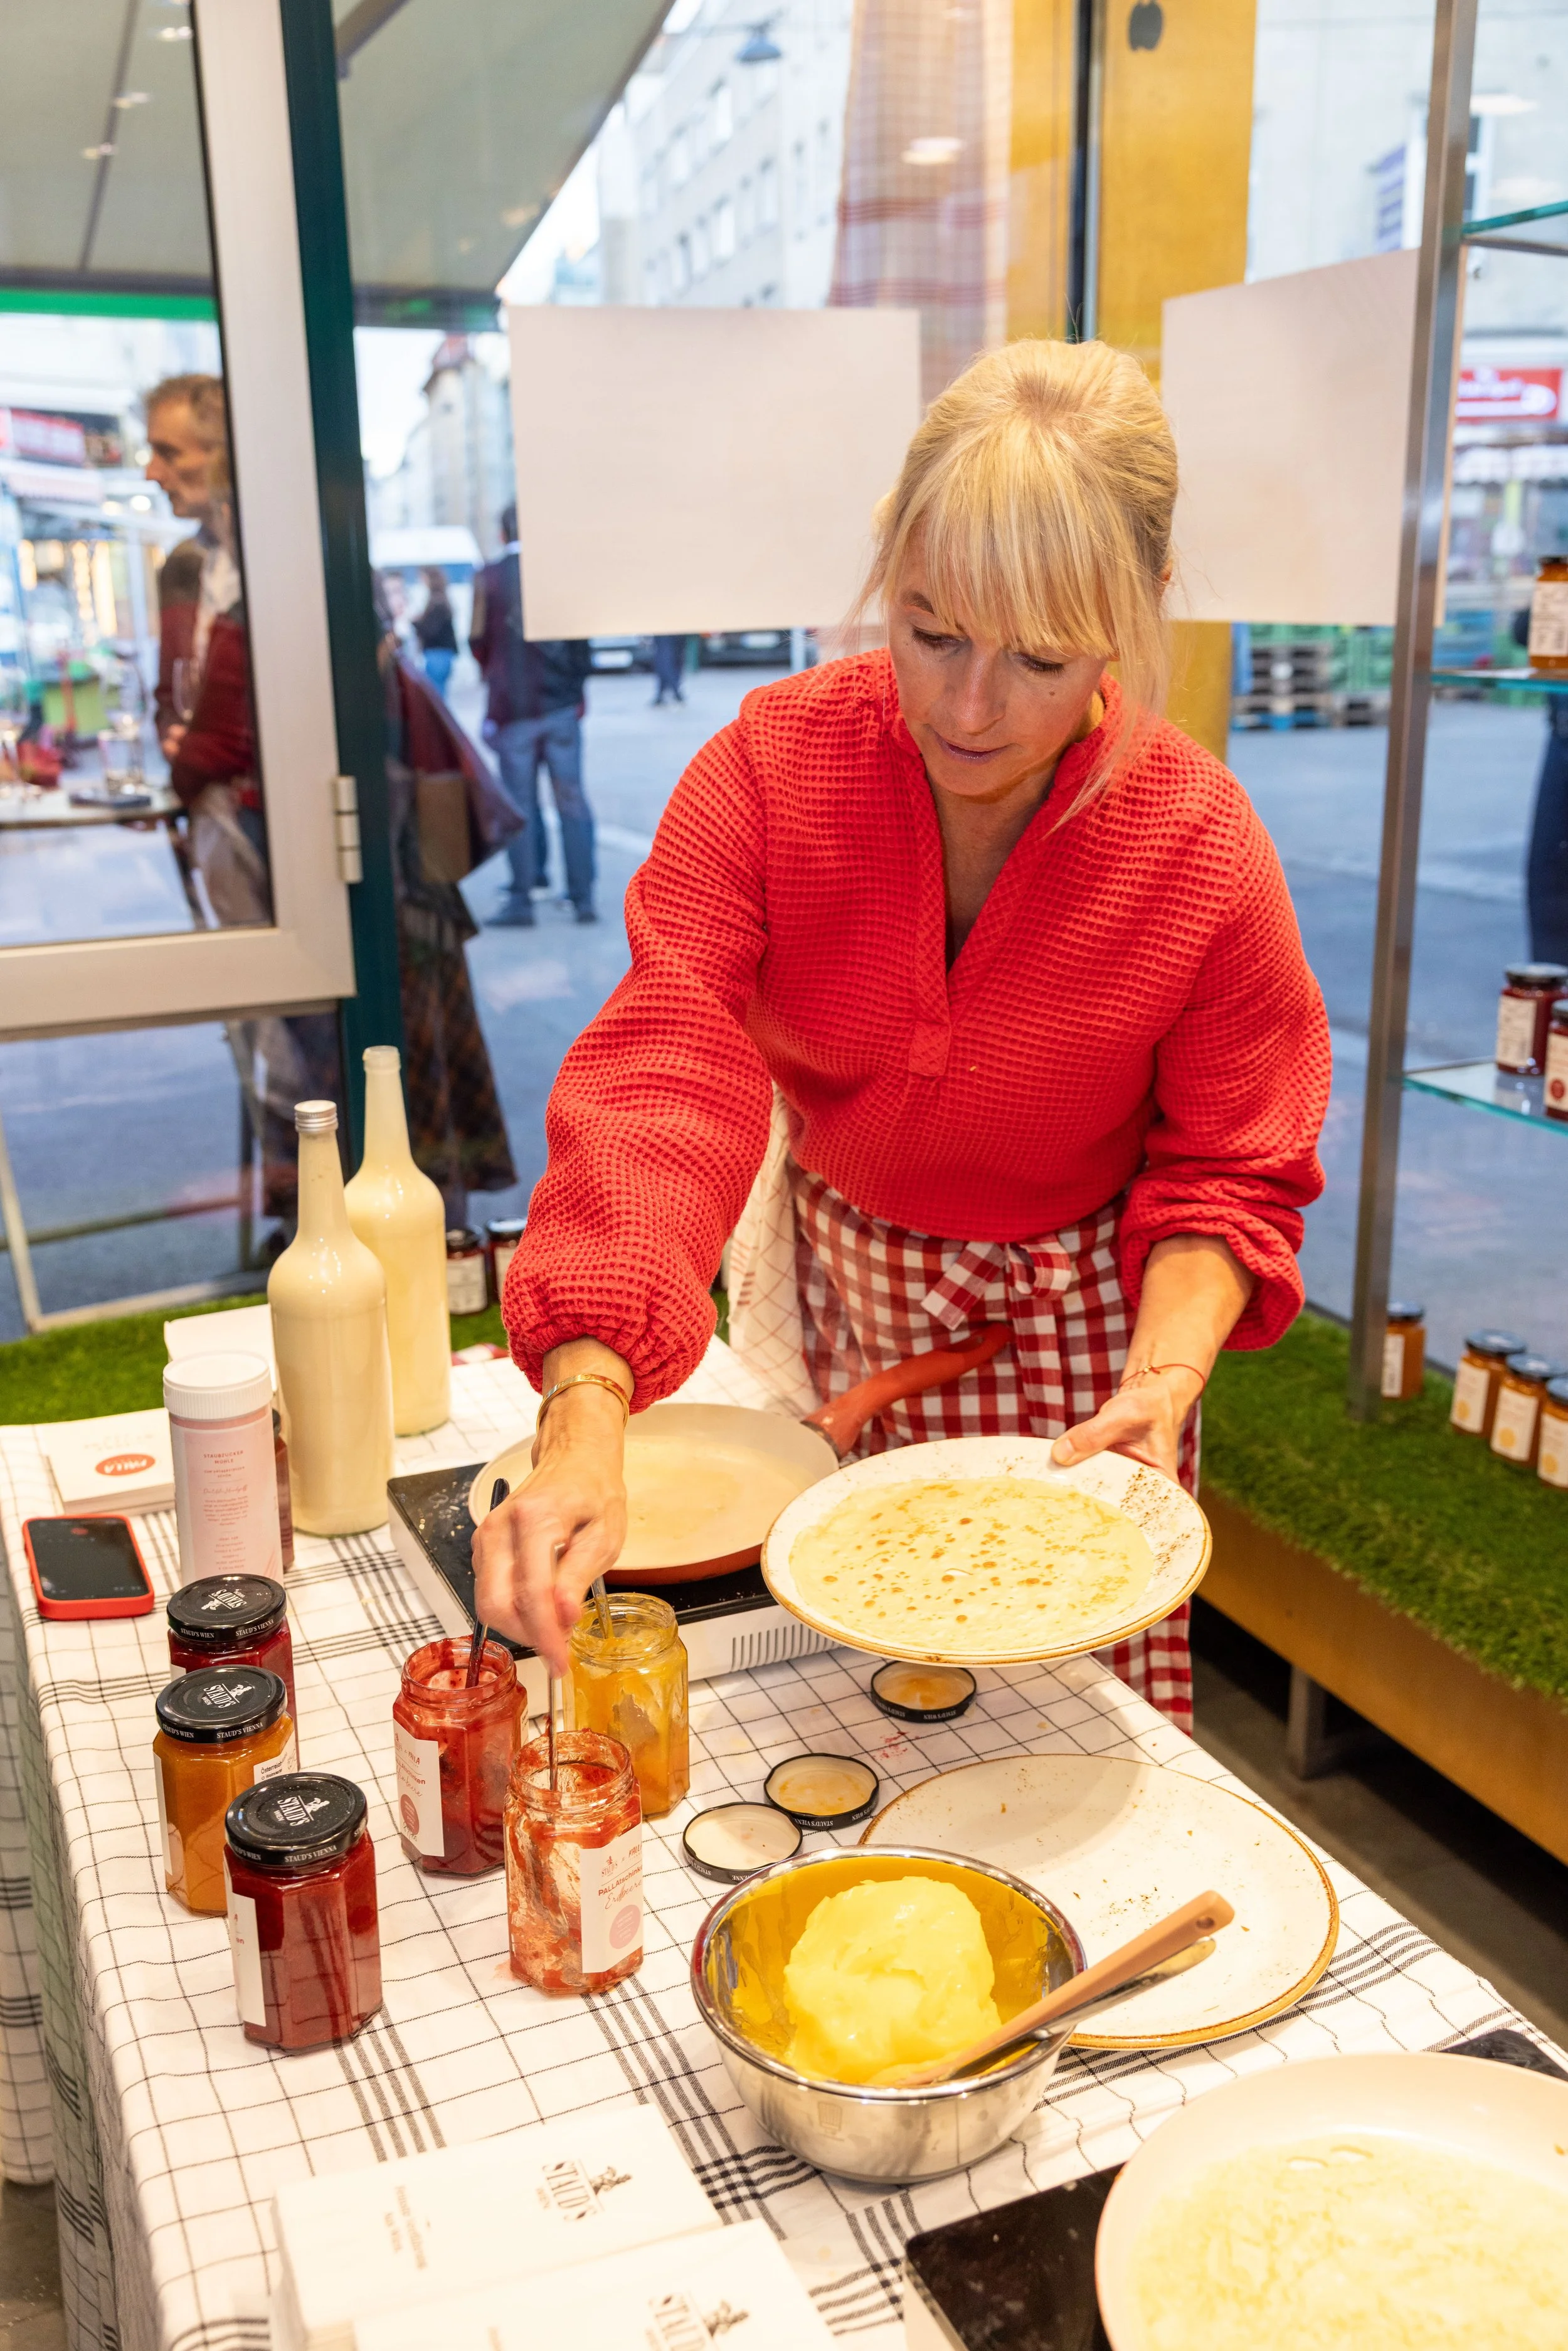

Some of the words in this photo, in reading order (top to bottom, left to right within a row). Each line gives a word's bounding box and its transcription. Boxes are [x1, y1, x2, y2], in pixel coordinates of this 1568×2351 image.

[211, 1589, 247, 1608] STAUD'S
[181, 1627, 199, 1637] STAUD'S
[235, 1627, 257, 1637] STAUD'S
[258, 1619, 274, 1630] VIENNA
[201, 1696, 213, 1706] WIEN
[203, 1684, 236, 1709] STAUD'S
[162, 1724, 179, 1735] STAUD'S
[179, 1730, 194, 1738] WIEN
[216, 1729, 242, 1739] STAUD'S
[243, 1722, 263, 1733] VIENNA
[273, 1810, 284, 1822] WIEN
[277, 1796, 311, 1826] STAUD'S
[852, 1812, 863, 1821] WIEN
[284, 1852, 312, 1863] STAUD'S
[313, 1845, 337, 1859] VIENNA
[598, 1864, 642, 1896] PALLAtschinke
[542, 2161, 597, 2221] STAUD'S
